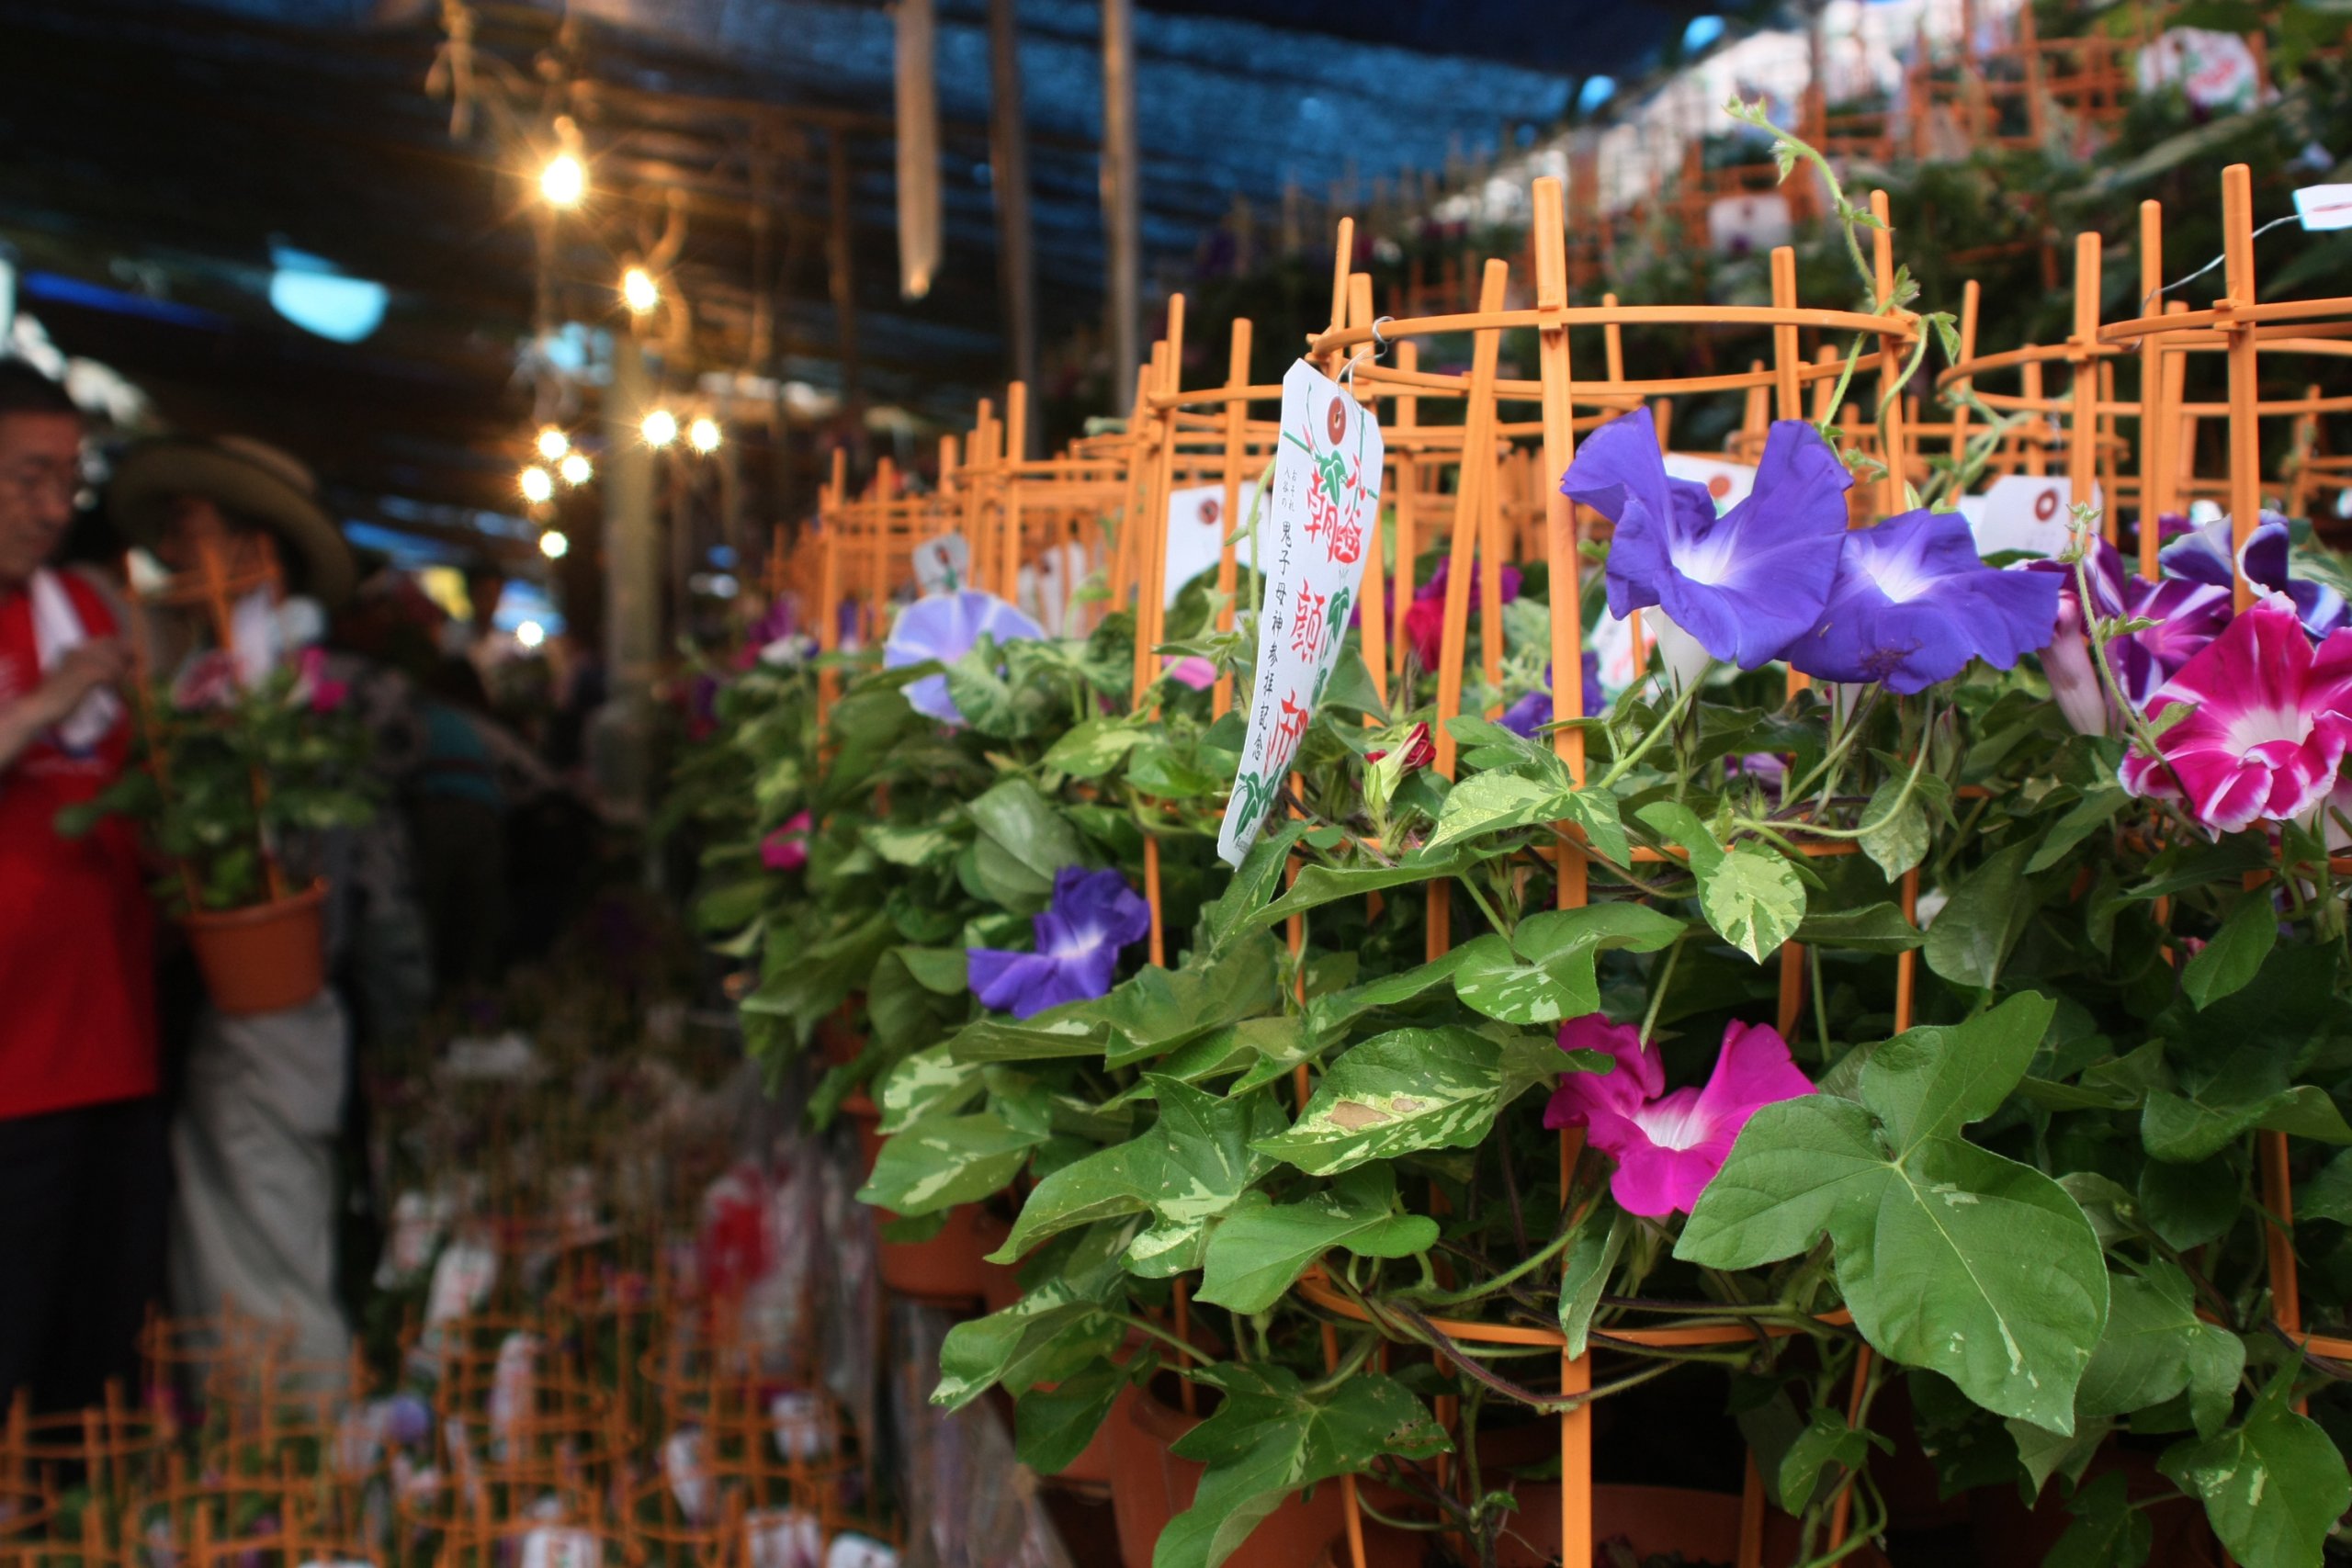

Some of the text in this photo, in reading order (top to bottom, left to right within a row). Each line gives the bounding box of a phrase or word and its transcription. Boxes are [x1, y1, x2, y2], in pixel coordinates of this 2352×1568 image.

[1251, 520, 1293, 761] 鬼子母神参拝記念
[1270, 464, 1339, 771] 朝顔市
